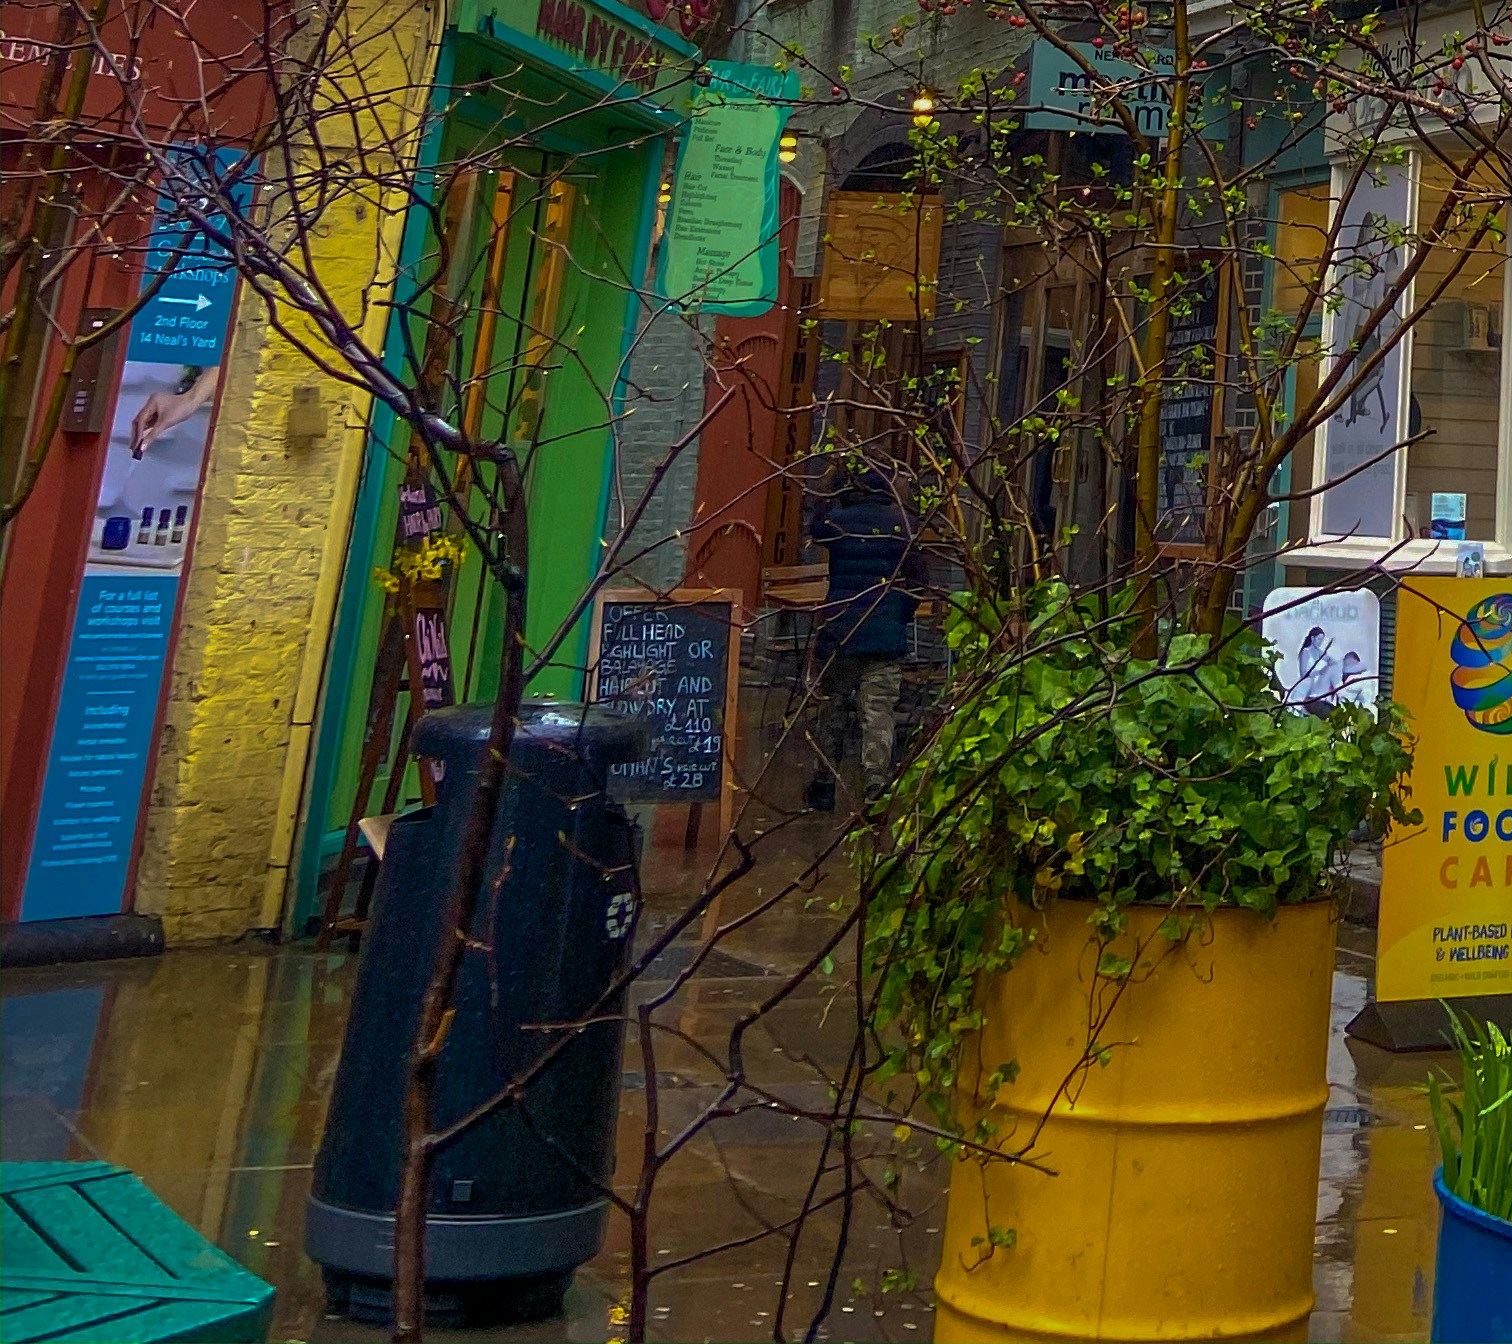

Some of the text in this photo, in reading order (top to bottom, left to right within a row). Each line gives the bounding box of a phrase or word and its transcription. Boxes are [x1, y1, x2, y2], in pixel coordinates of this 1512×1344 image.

[745, 146, 766, 159] Body
[154, 315, 209, 330] 2nd Floor
[140, 332, 216, 348] 14 Neal's Yard
[642, 623, 686, 641] HEAD
[688, 639, 714, 659] OR
[677, 675, 713, 695] AND
[686, 698, 710, 720] AT
[1432, 923, 1507, 943] PLANT-BASED
[1435, 947, 1446, 962] &
[1449, 944, 1510, 962] WELLBEING
